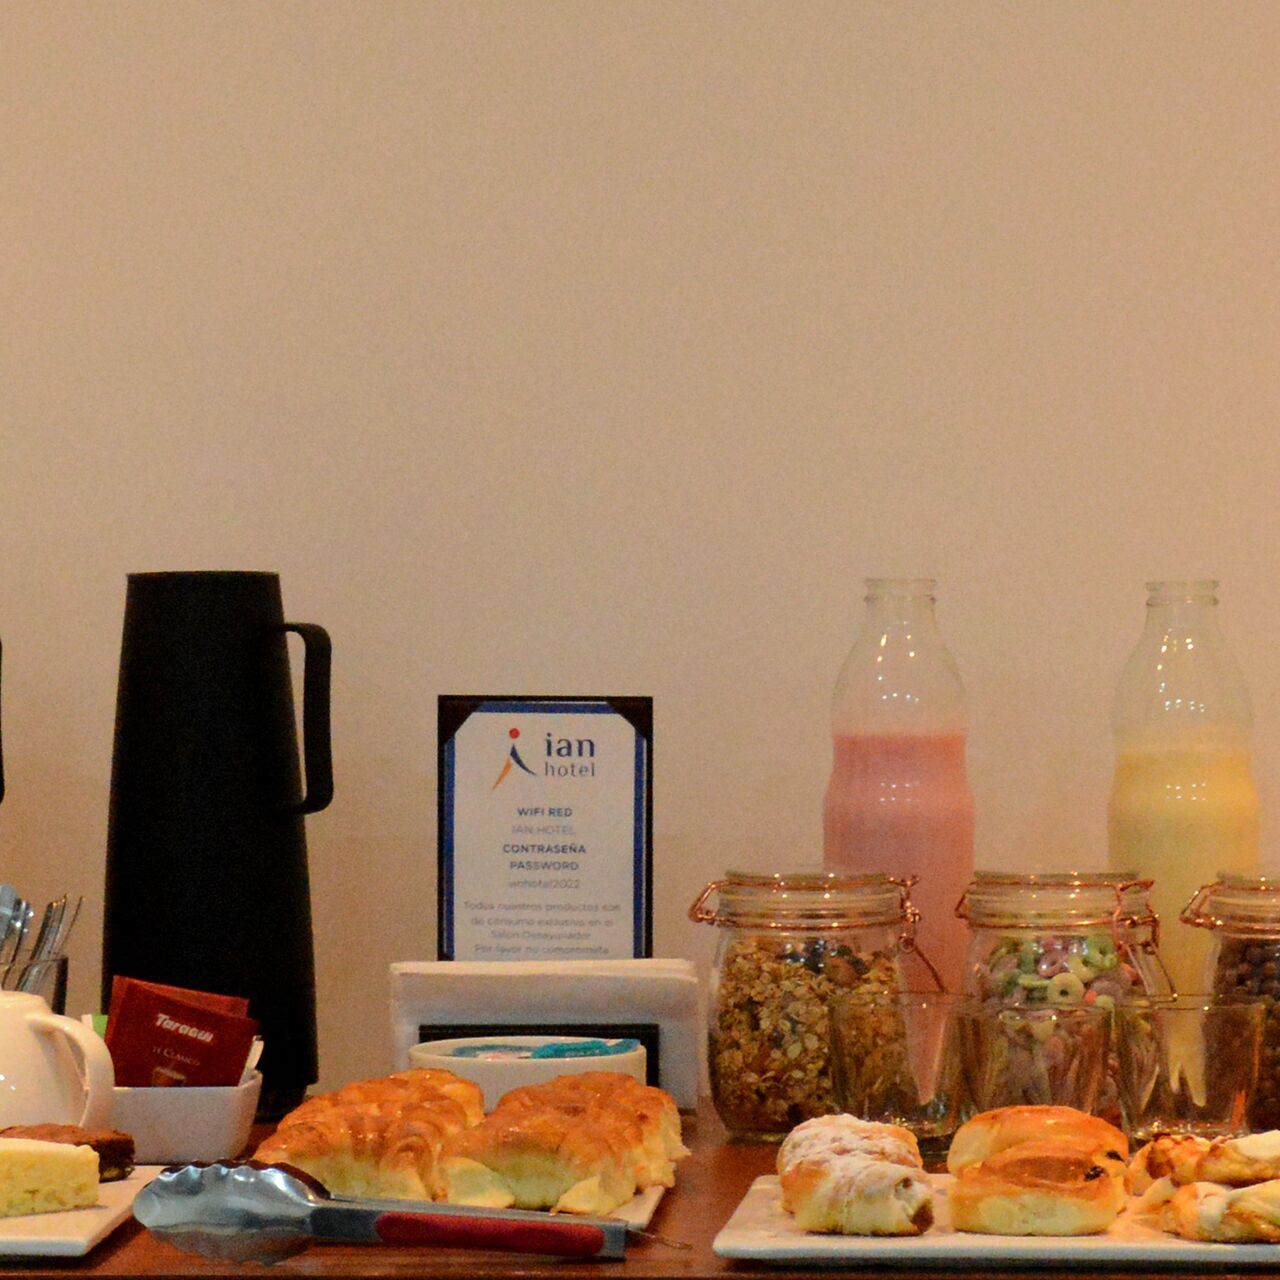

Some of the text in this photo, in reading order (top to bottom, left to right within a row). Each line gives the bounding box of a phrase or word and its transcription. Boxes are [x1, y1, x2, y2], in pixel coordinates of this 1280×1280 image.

[545, 732, 595, 757] ian
[544, 761, 596, 777] hotel
[517, 807, 573, 817] WIFI RED
[503, 842, 586, 854] CONTRASEÑA
[509, 860, 579, 870] PASSWORD
